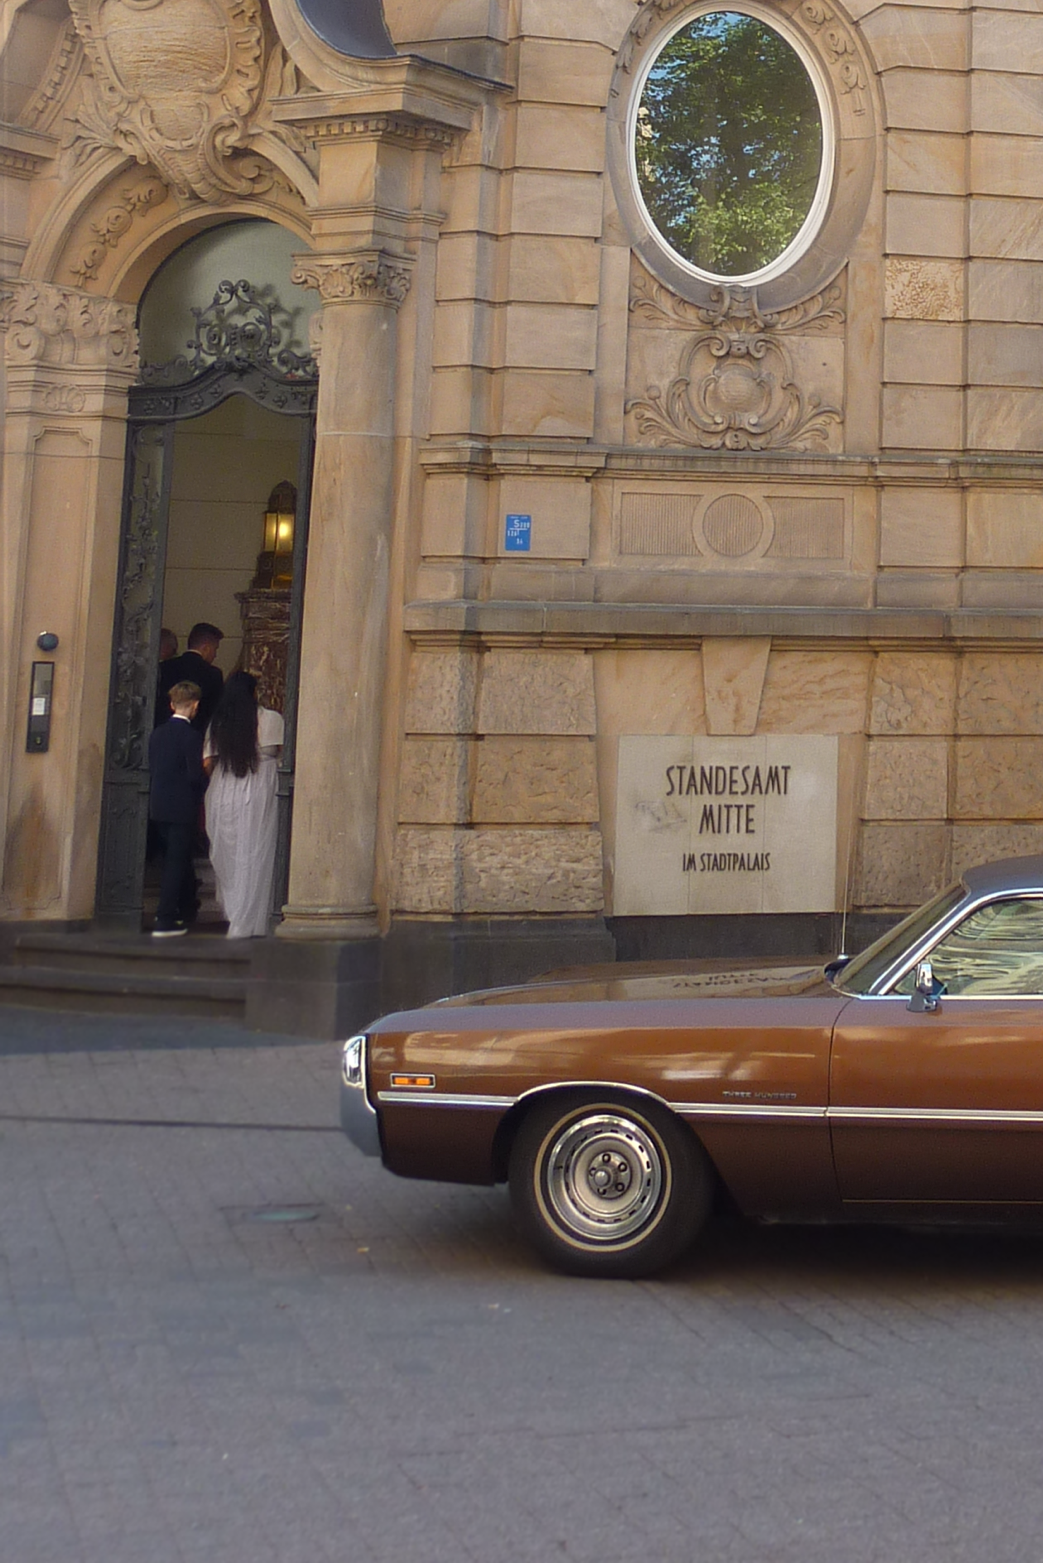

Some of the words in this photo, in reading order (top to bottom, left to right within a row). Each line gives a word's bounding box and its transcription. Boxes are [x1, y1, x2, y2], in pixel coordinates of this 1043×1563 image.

[665, 765, 791, 796] STANDESAMT
[698, 804, 755, 834] MITTE
[682, 853, 697, 872] IM
[700, 852, 770, 872] STADTPALAIS
